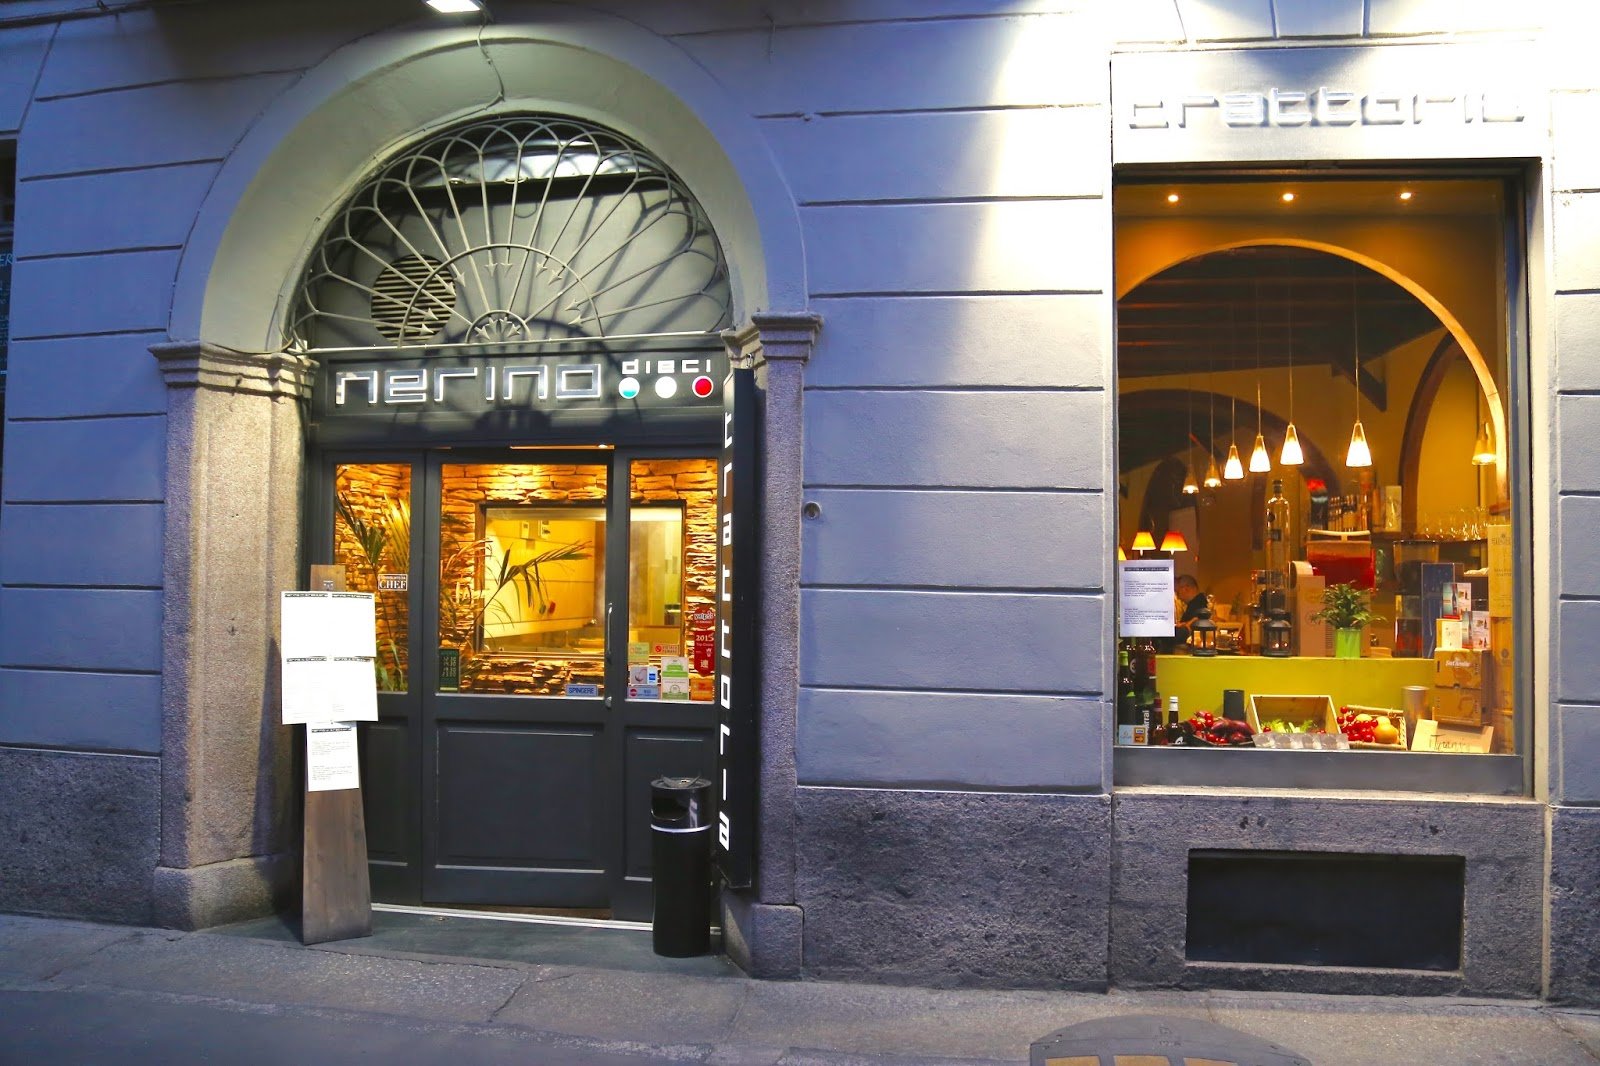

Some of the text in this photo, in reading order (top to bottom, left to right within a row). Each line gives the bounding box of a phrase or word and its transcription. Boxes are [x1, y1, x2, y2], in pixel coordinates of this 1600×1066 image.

[622, 359, 711, 375] dieci
[335, 364, 601, 405] nerino
[379, 580, 407, 589] CHEF
[696, 633, 715, 642] 2015
[719, 412, 732, 851] trattoria
[568, 687, 594, 695] SPINGERE
